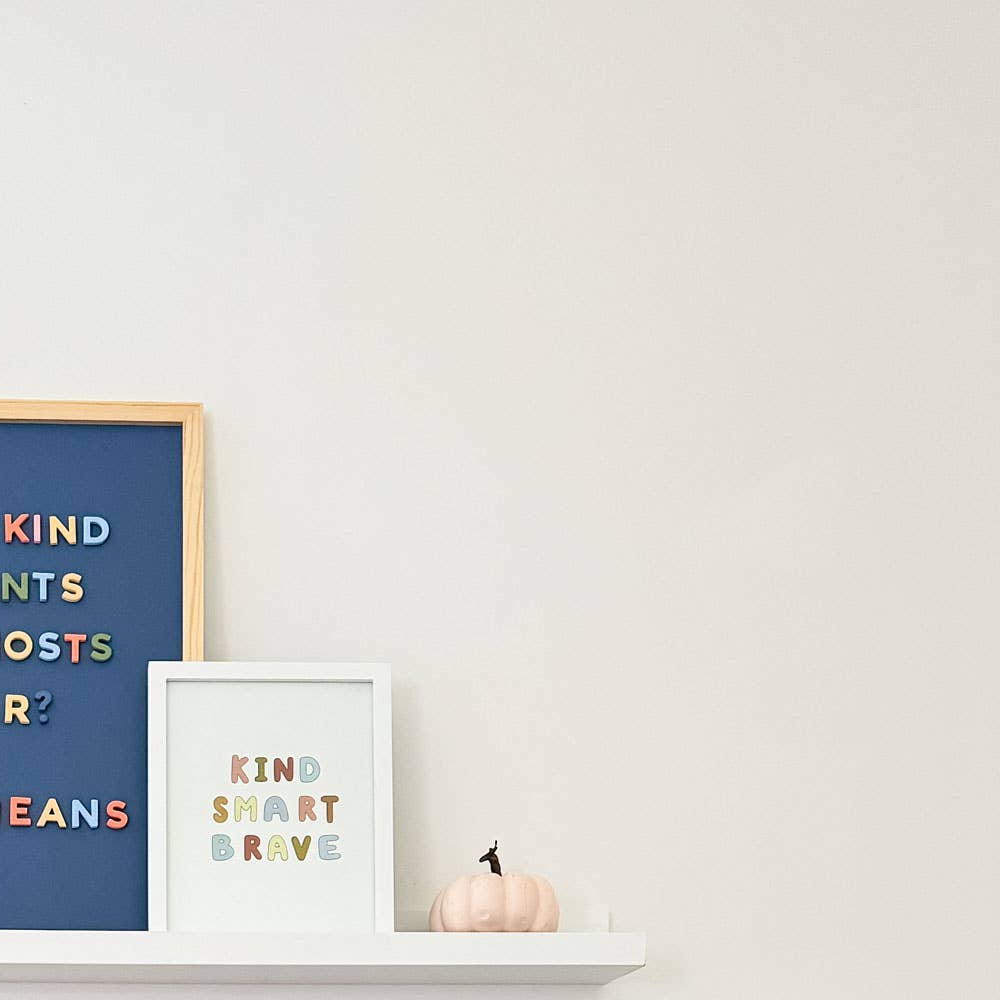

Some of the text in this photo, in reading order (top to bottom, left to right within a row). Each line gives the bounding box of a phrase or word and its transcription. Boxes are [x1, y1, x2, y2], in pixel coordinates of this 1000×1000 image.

[3, 513, 111, 546] KIND
[230, 754, 320, 785] KIND
[212, 795, 340, 823] SMART
[211, 834, 342, 862] BRAVE
